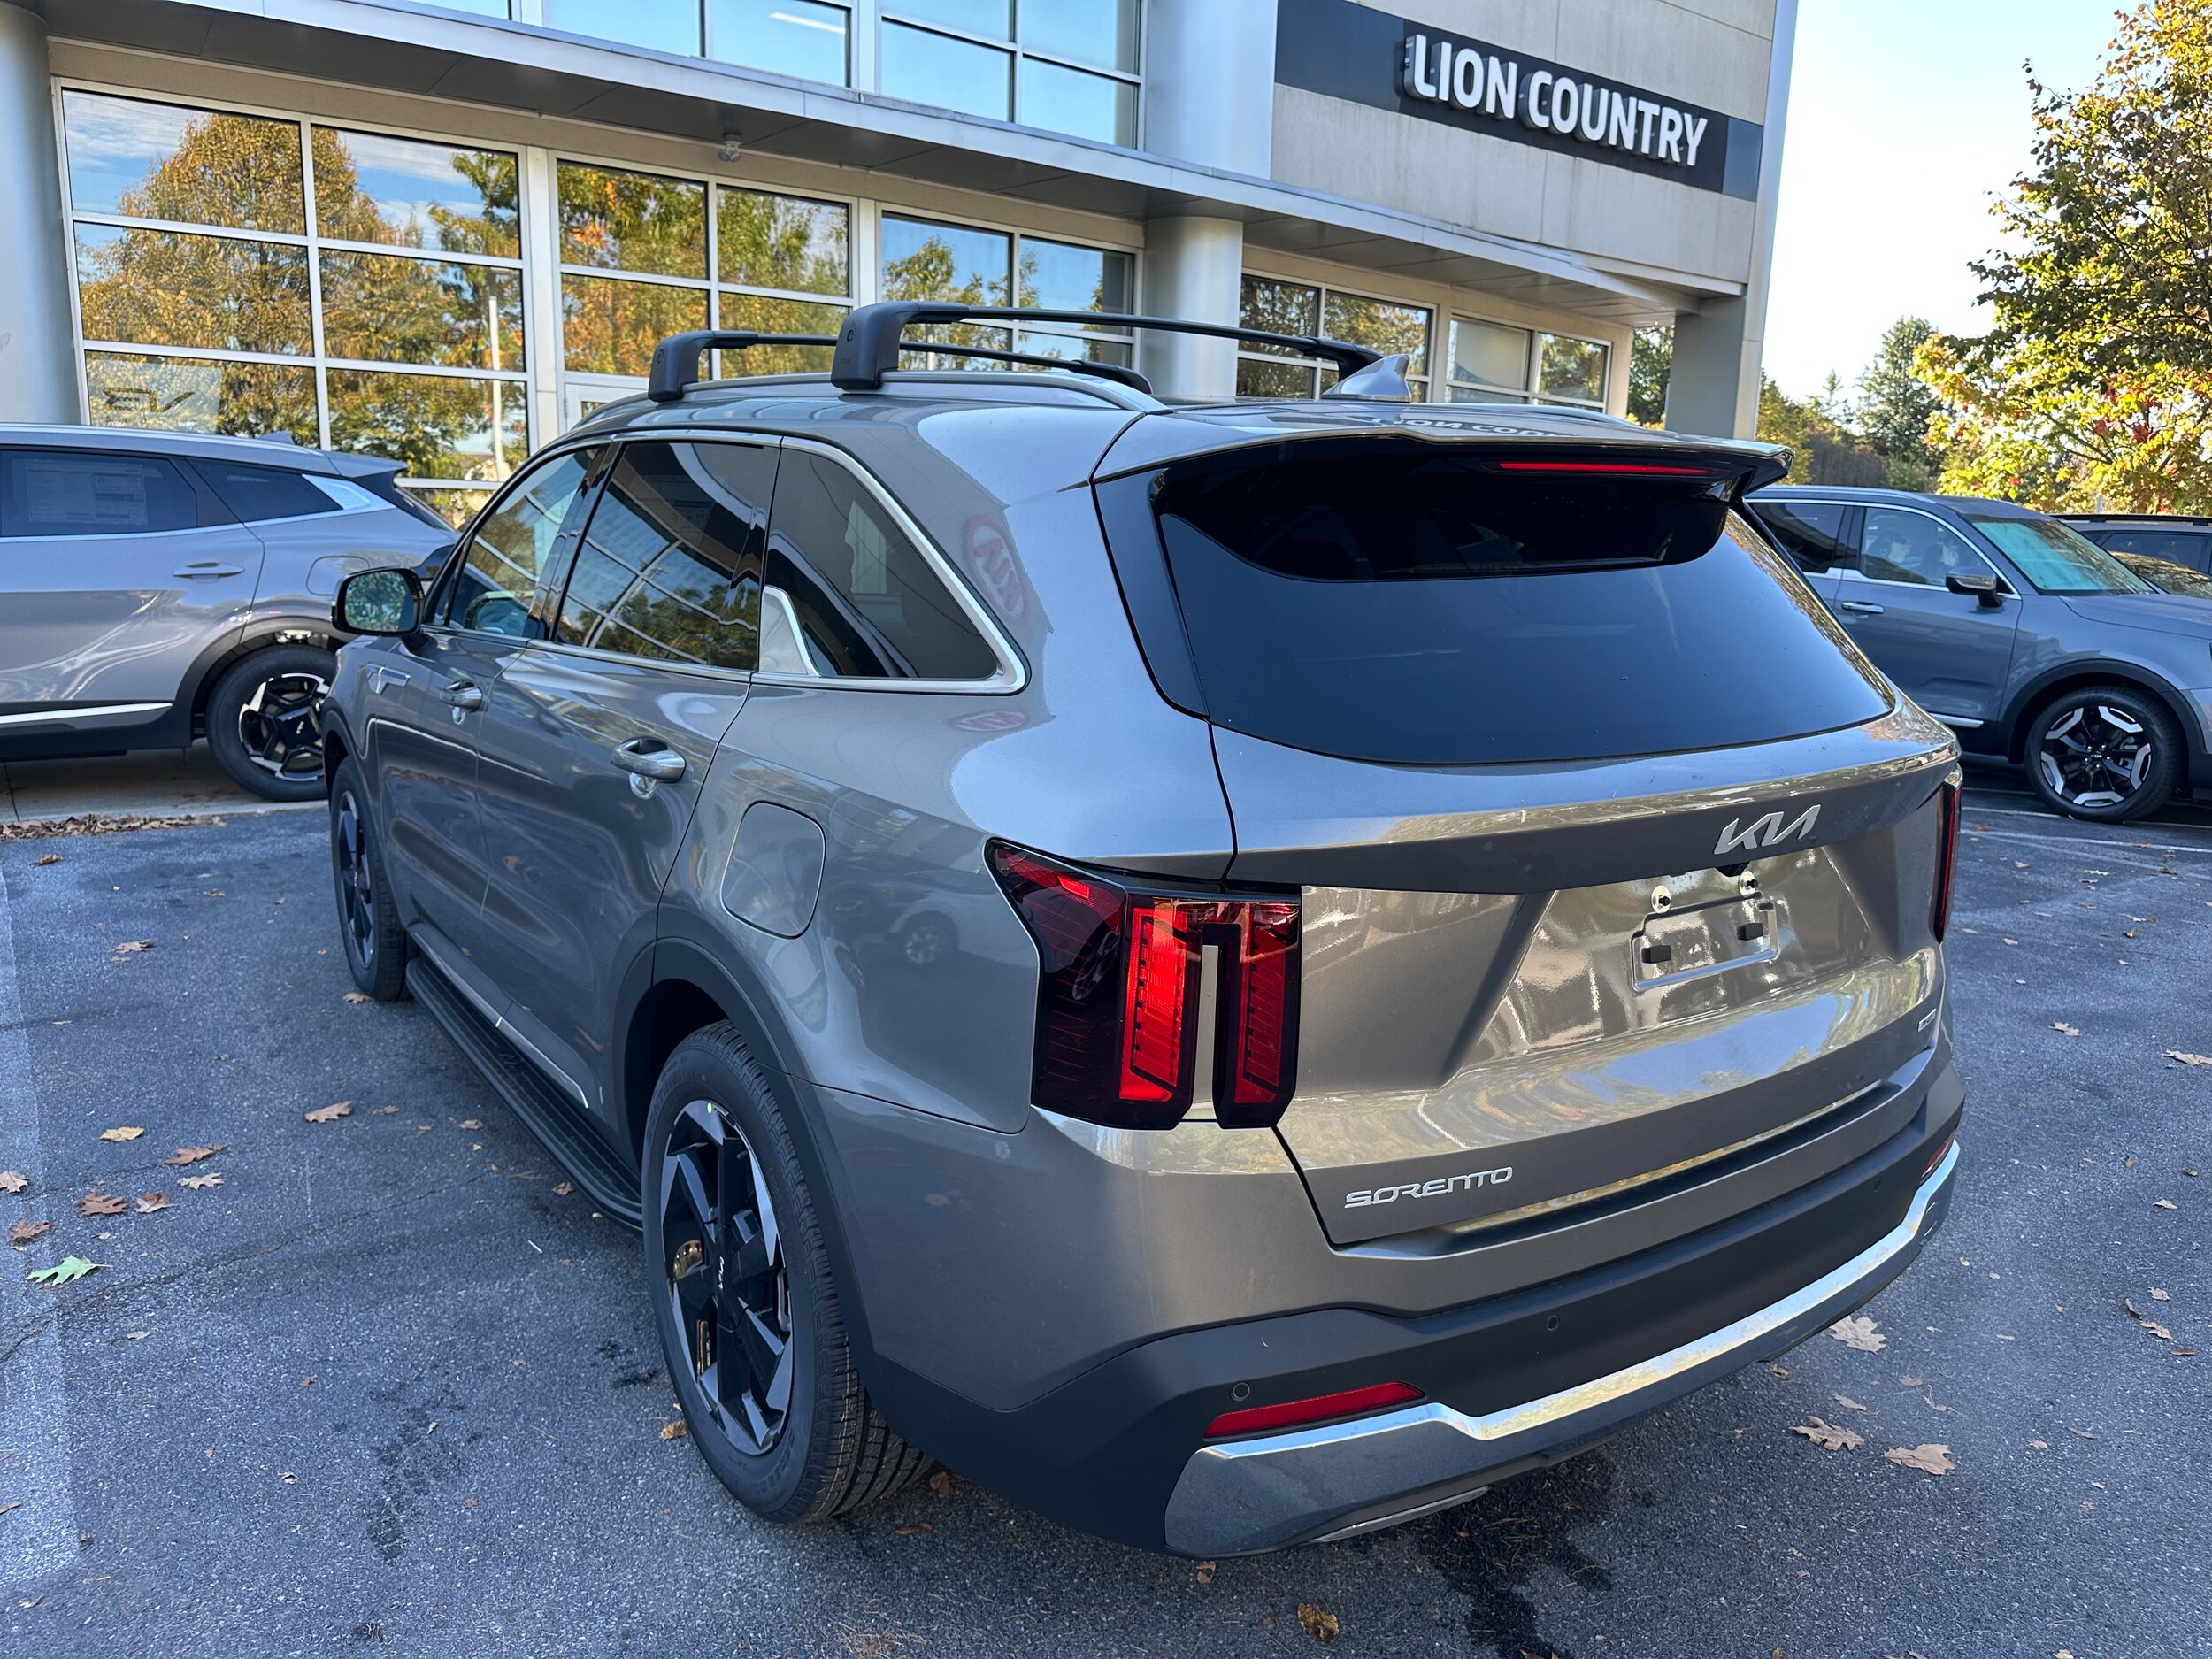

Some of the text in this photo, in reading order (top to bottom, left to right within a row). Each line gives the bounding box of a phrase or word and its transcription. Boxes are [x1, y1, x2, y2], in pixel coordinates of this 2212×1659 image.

[1411, 34, 1708, 167] LION COUNTRY
[1713, 804, 1821, 855] KIA
[1344, 1166, 1513, 1209] SORENTO
